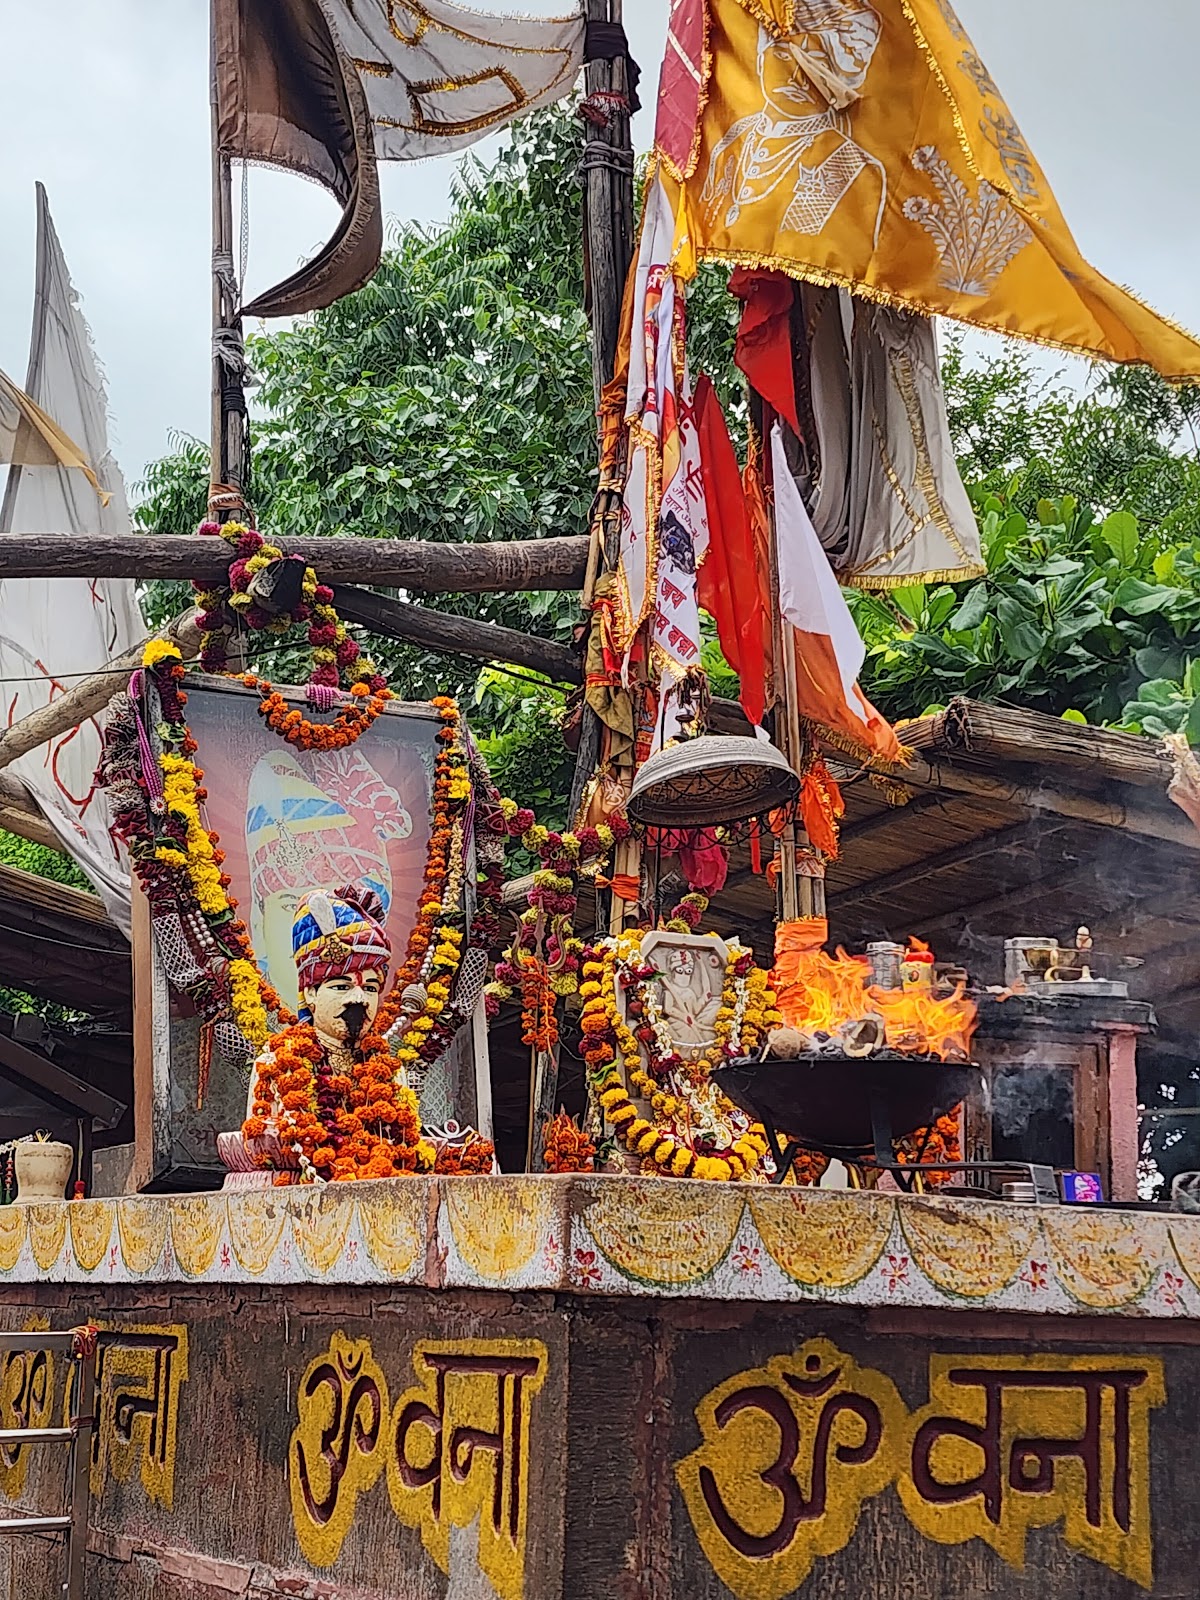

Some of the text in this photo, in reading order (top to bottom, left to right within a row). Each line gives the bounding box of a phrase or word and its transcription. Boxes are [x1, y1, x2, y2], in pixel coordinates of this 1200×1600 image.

[656, 601, 698, 660] म बन्ना
[661, 577, 687, 610] जय
[298, 1350, 381, 1525] ॐ
[700, 1355, 882, 1559] ॐ
